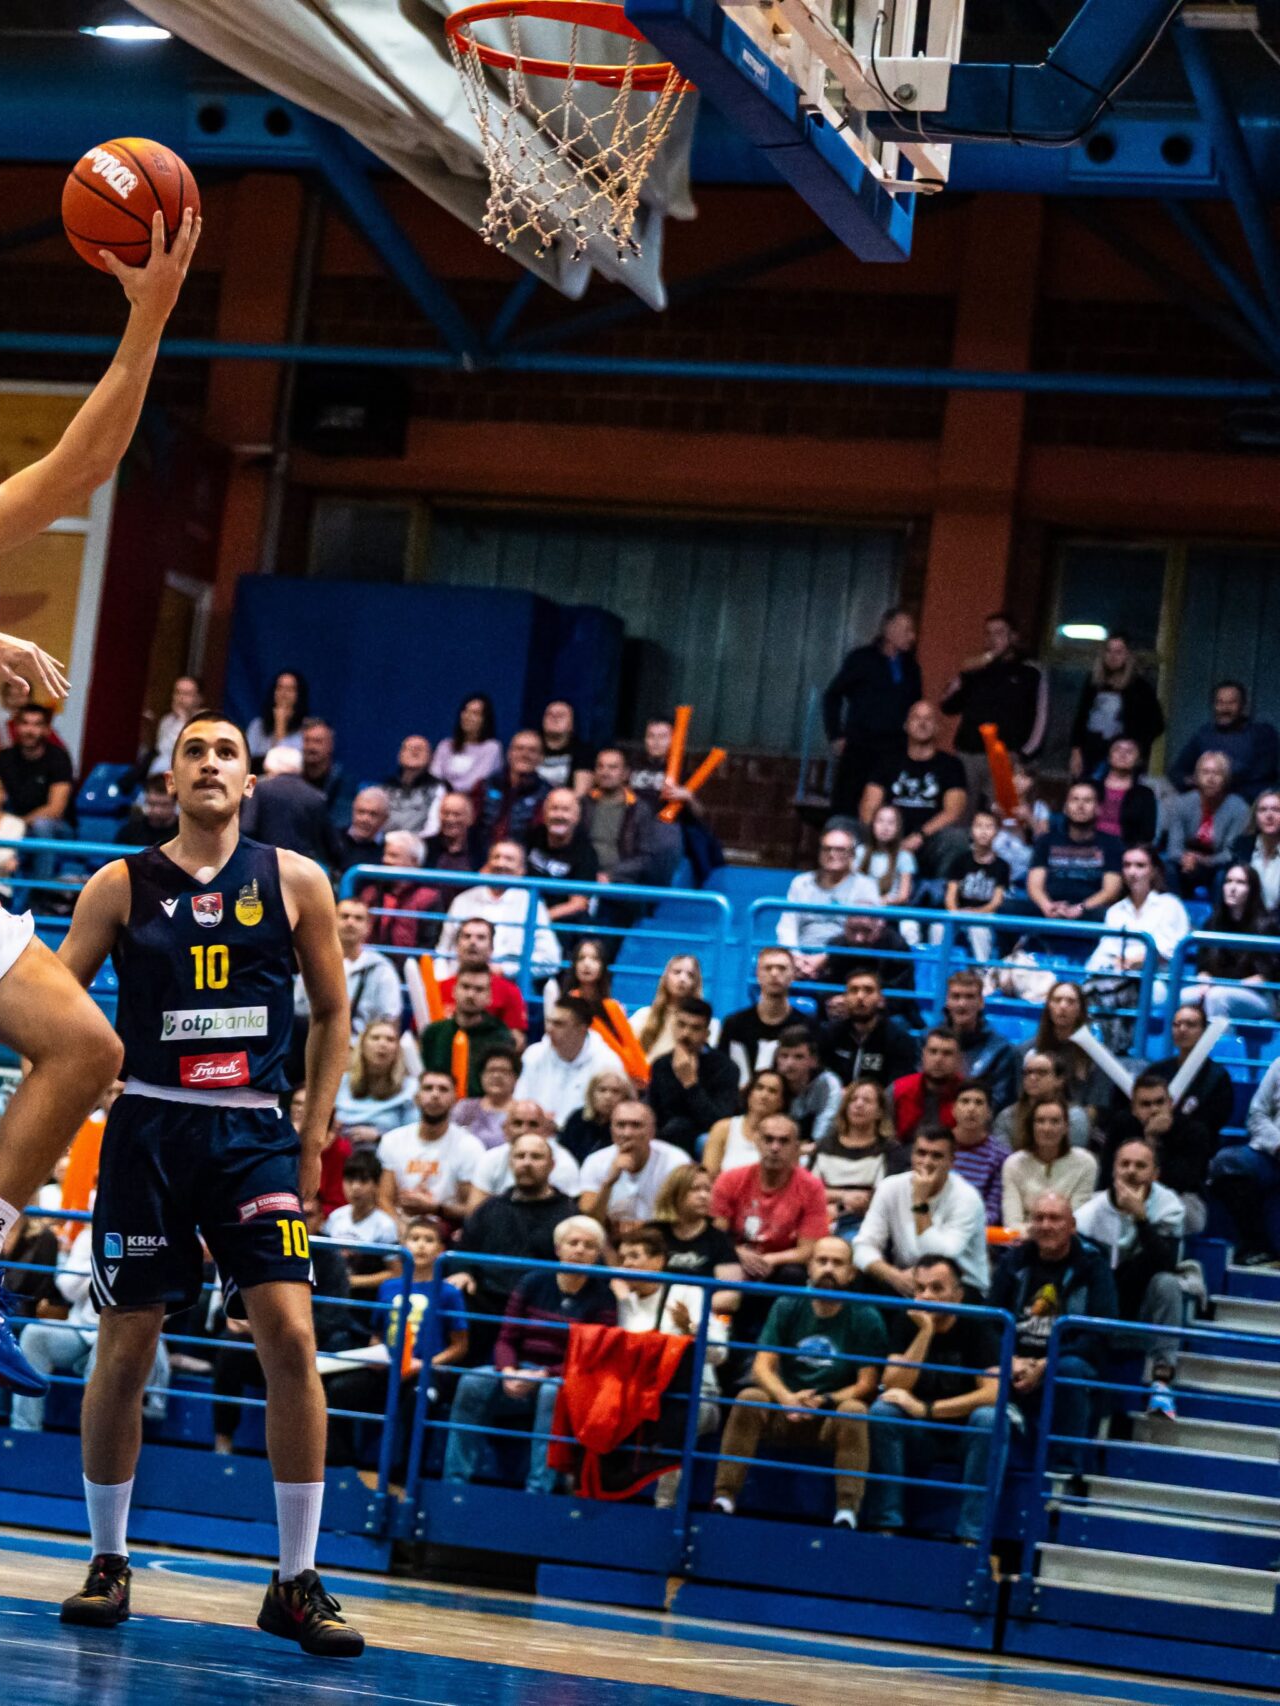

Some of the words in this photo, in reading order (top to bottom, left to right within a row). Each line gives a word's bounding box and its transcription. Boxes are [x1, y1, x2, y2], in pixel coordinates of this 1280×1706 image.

[190, 944, 230, 990] 10
[181, 1010, 265, 1036] otpbanka
[189, 1060, 241, 1078] Franck
[127, 1235, 169, 1247] KRKA
[276, 1219, 310, 1259] 10
